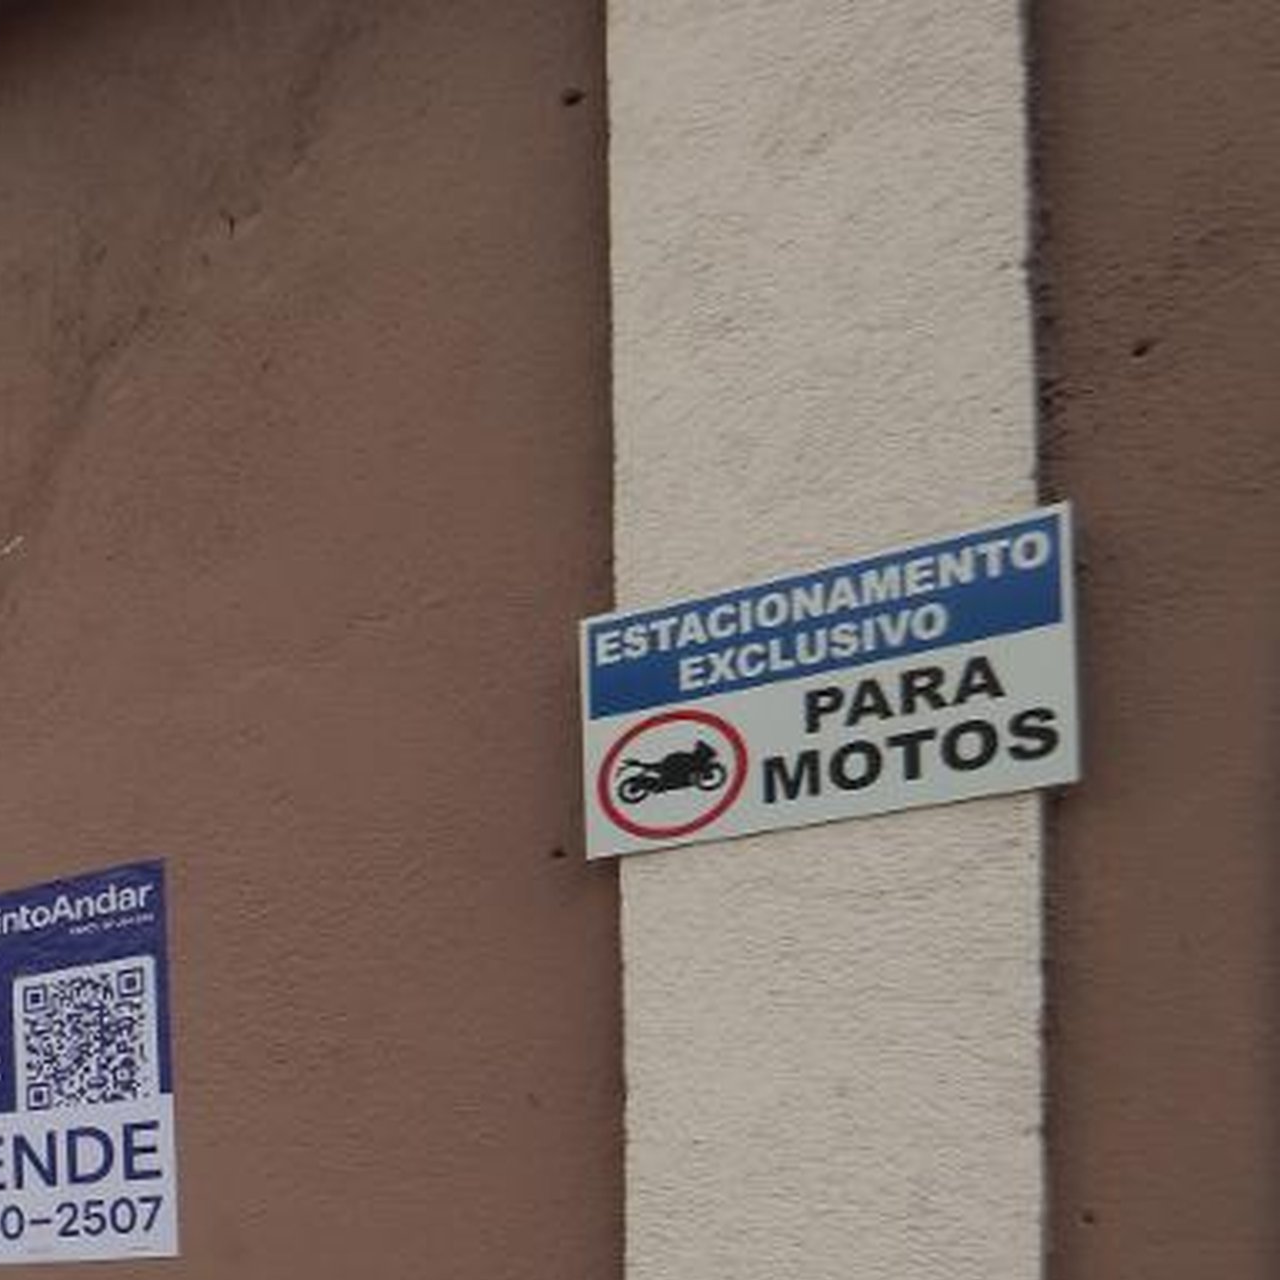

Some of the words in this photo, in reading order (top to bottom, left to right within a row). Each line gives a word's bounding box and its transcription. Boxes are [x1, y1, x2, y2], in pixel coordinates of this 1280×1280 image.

[594, 530, 1052, 667] ESTACIONAMENTO
[678, 603, 948, 693] EXCLUSIVO
[803, 656, 1007, 734] PARA
[761, 706, 1060, 804] MOTOS
